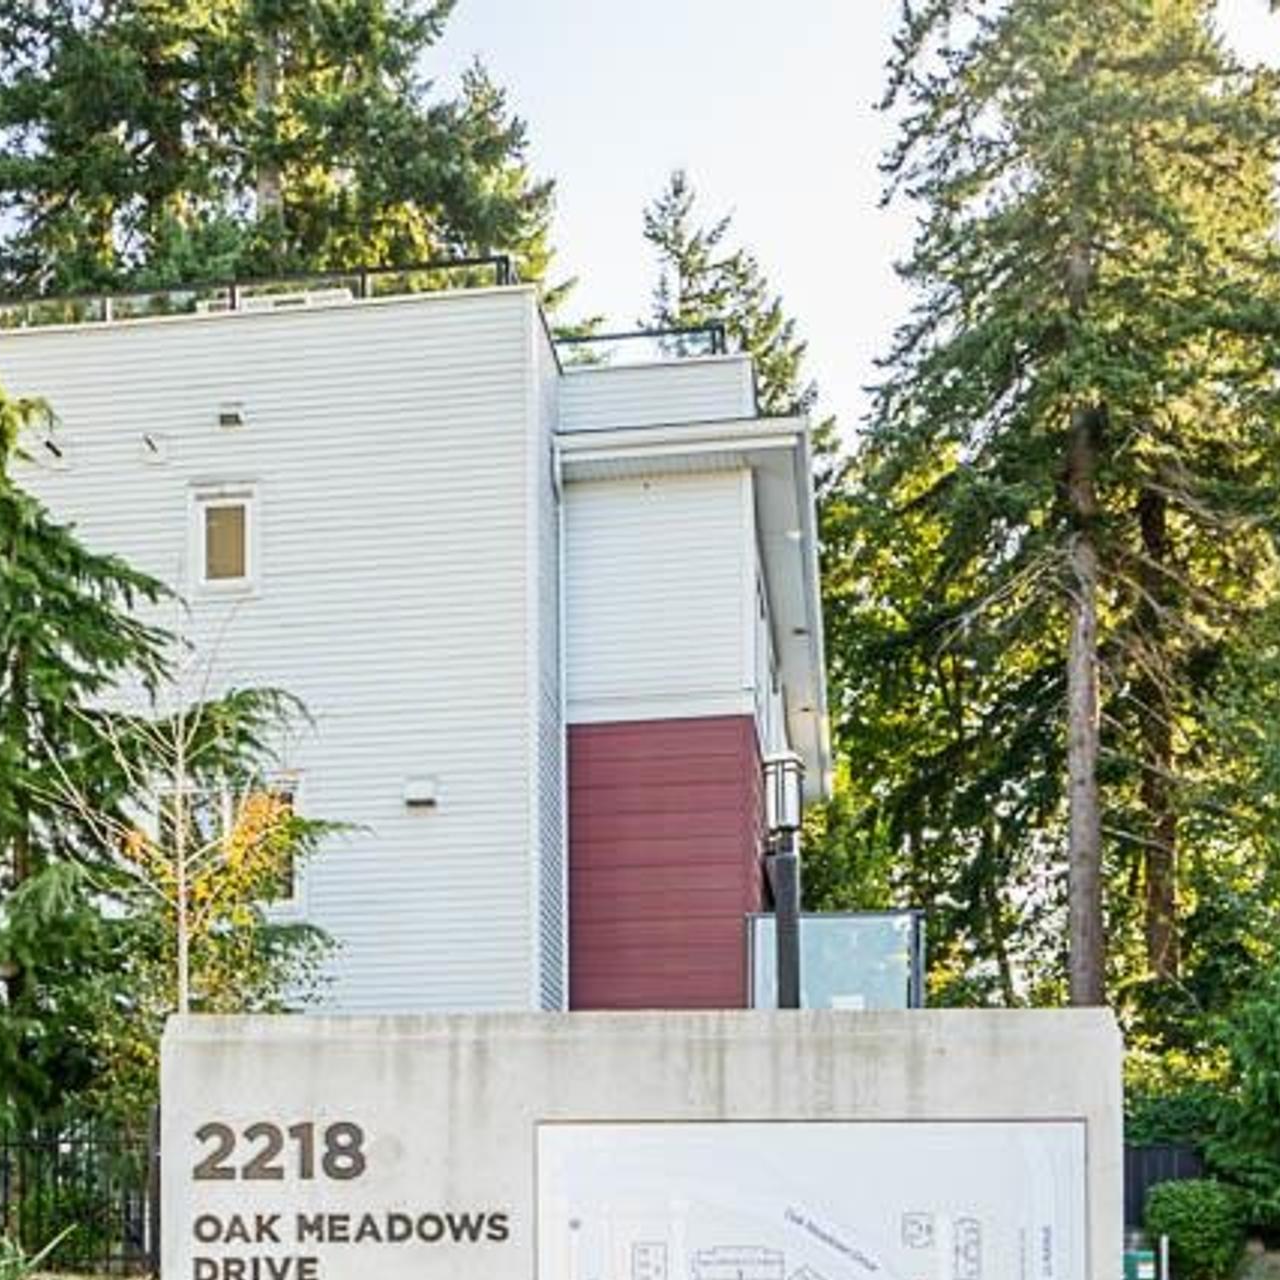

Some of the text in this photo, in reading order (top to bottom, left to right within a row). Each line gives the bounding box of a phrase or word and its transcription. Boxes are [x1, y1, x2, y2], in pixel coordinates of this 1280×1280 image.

[192, 1121, 367, 1181] 2218
[193, 1212, 509, 1244] OAK MEADOWS
